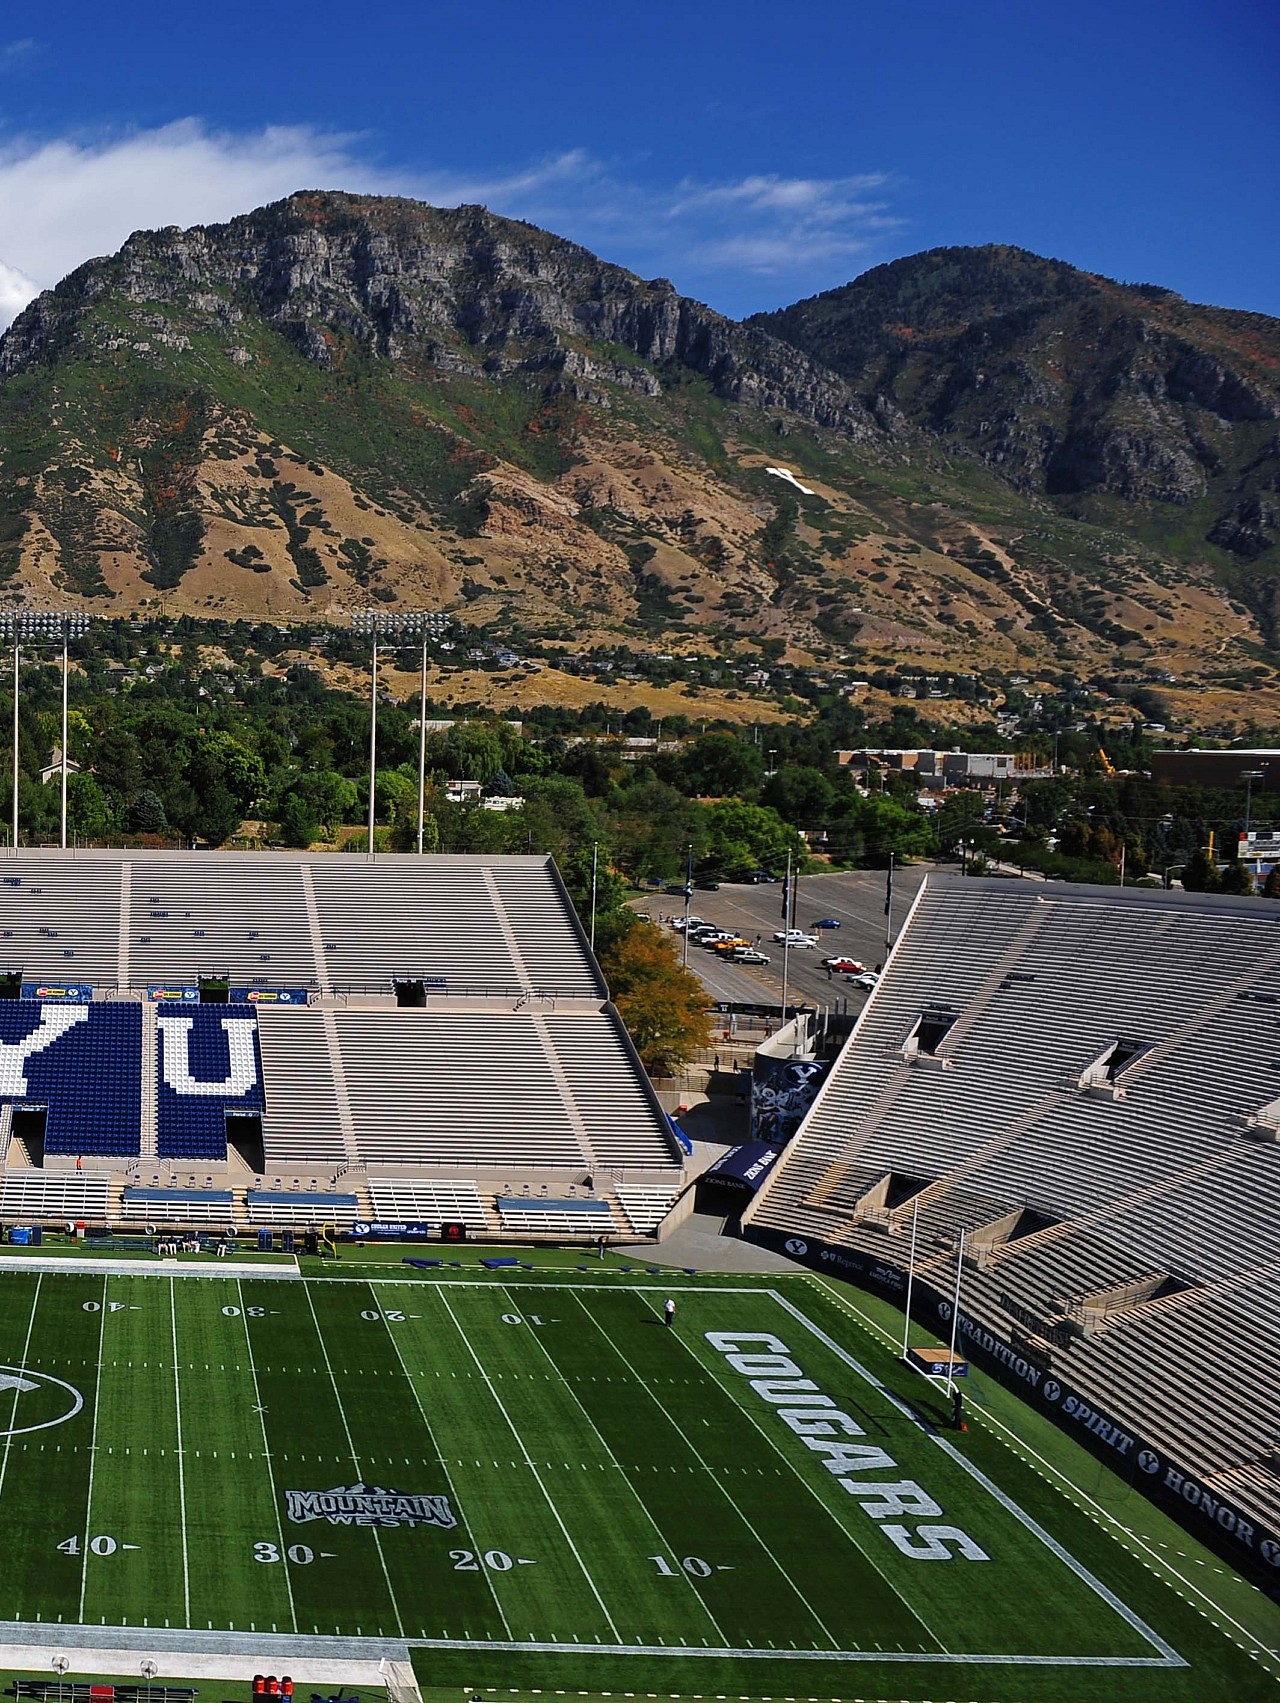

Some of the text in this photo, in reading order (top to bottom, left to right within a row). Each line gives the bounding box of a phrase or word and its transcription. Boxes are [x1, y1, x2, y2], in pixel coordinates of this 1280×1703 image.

[790, 1065, 818, 1084] Y
[743, 1163, 765, 1180] ZIONS
[757, 1150, 778, 1166] BANK
[956, 1313, 1042, 1388] TRADITION
[1061, 1396, 1135, 1455] SPIRIT
[1163, 1467, 1256, 1548] HONOR
[703, 1331, 992, 1562] COUGARS
[288, 1490, 455, 1528] MOUNTAIN
[325, 1514, 416, 1528] WEST
[56, 1534, 118, 1557] 40
[253, 1541, 315, 1566] 30
[449, 1549, 514, 1572] 20
[647, 1554, 714, 1578] 10
